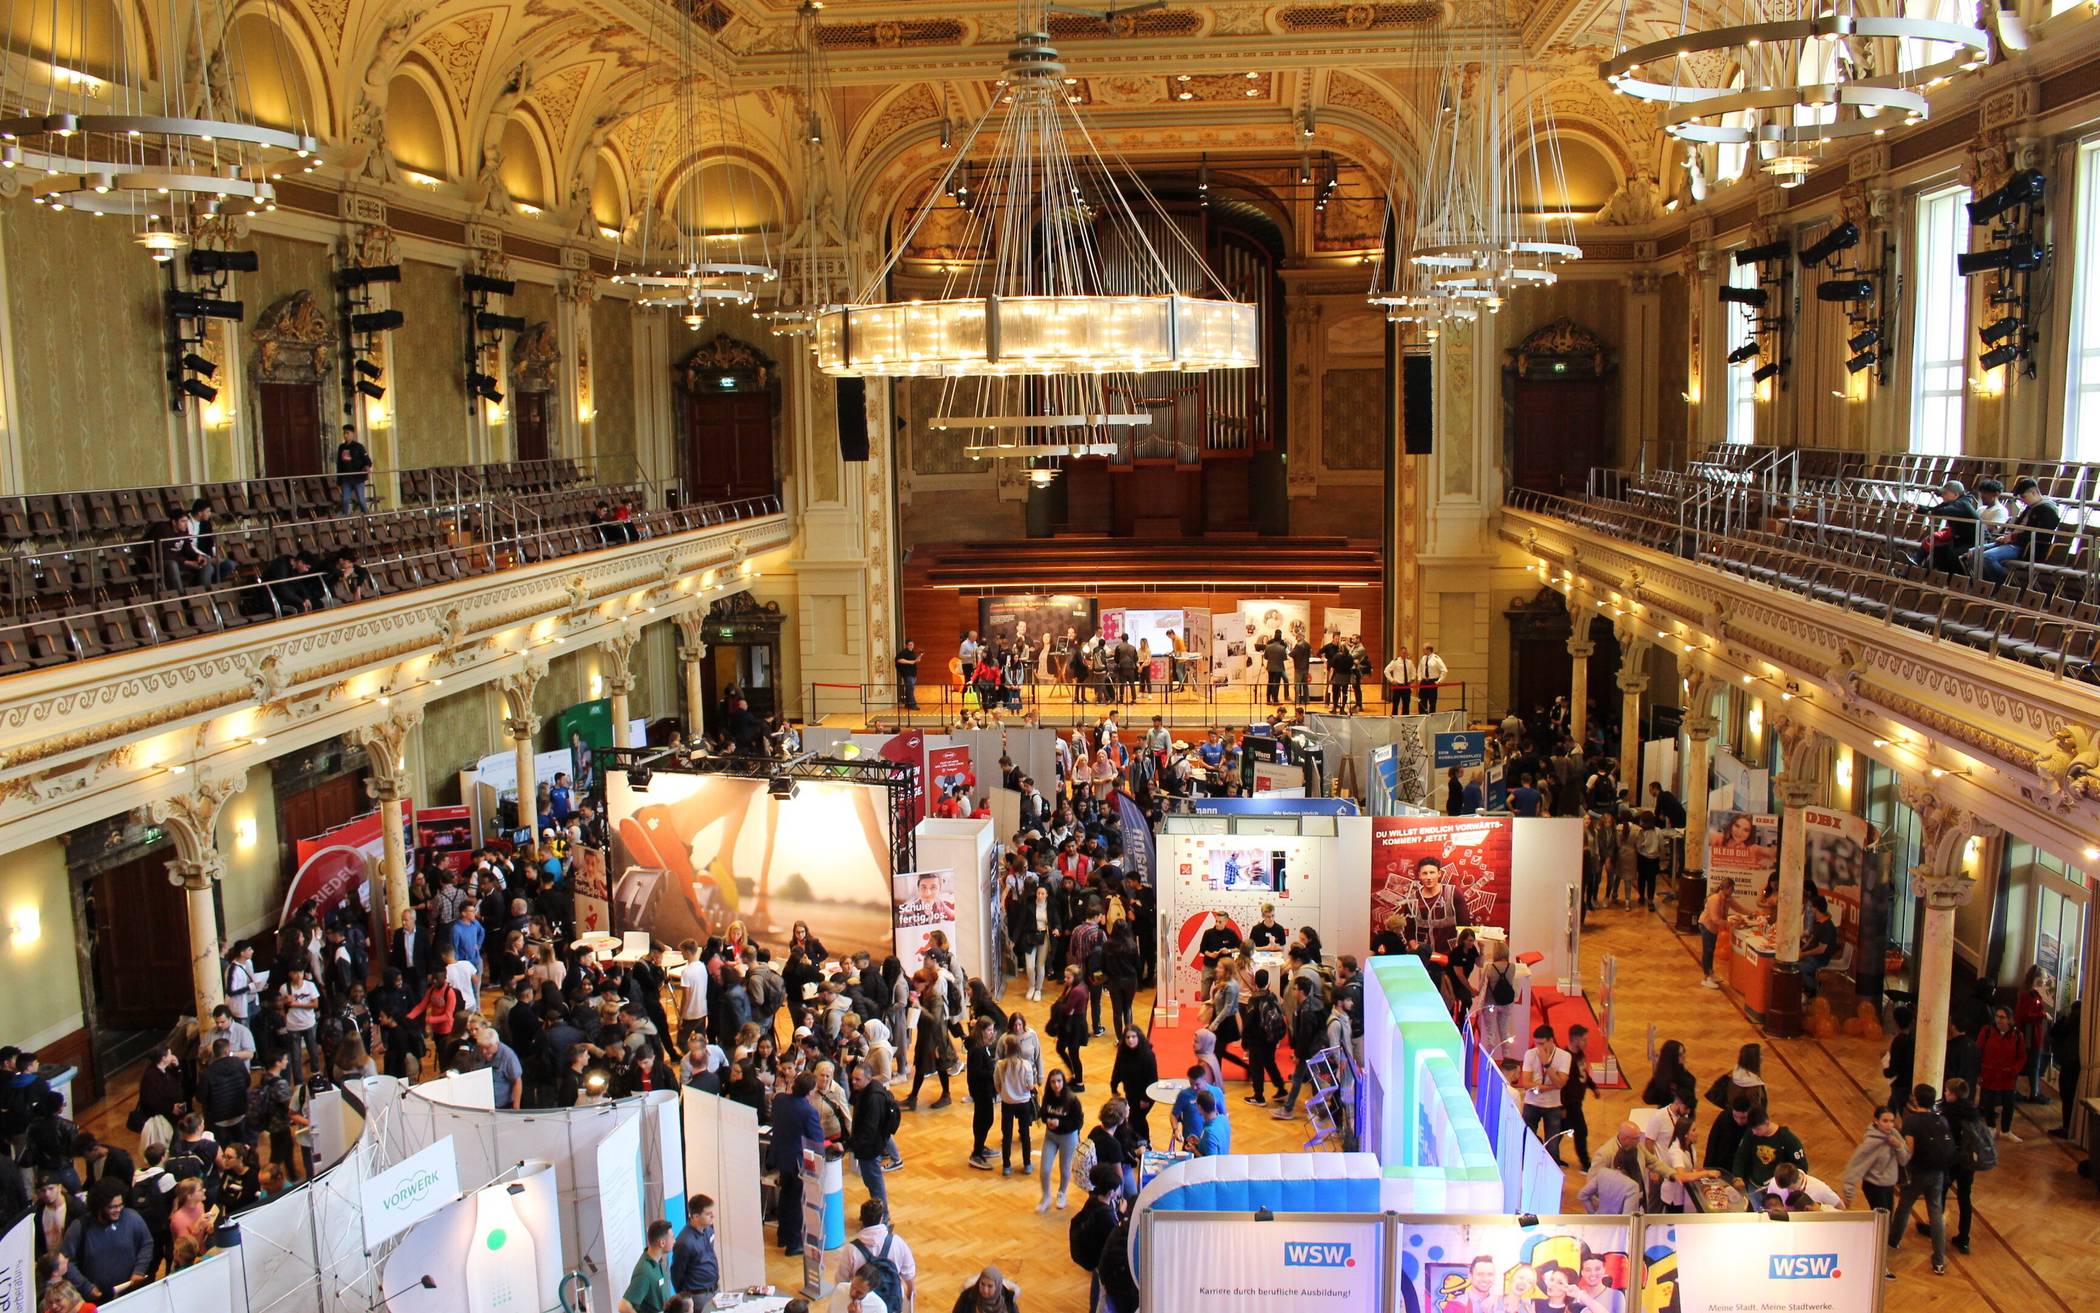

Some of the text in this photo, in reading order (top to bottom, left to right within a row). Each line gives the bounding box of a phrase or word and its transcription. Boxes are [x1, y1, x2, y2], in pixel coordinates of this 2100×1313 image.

[1389, 828, 1417, 837] WILLST
[1419, 826, 1453, 835] ENDLICH
[1382, 838, 1422, 846] KOMMEN?
[1424, 834, 1447, 842] JETZT
[383, 1170, 440, 1210] VORWERK
[1288, 1245, 1345, 1264] WSW
[1773, 1256, 1831, 1276] WSW
[1199, 1287, 1351, 1299] Karriere durch berufliche Ausbildung!
[1708, 1302, 1834, 1312] Meine Stadt. Meine Stadtwerke.
